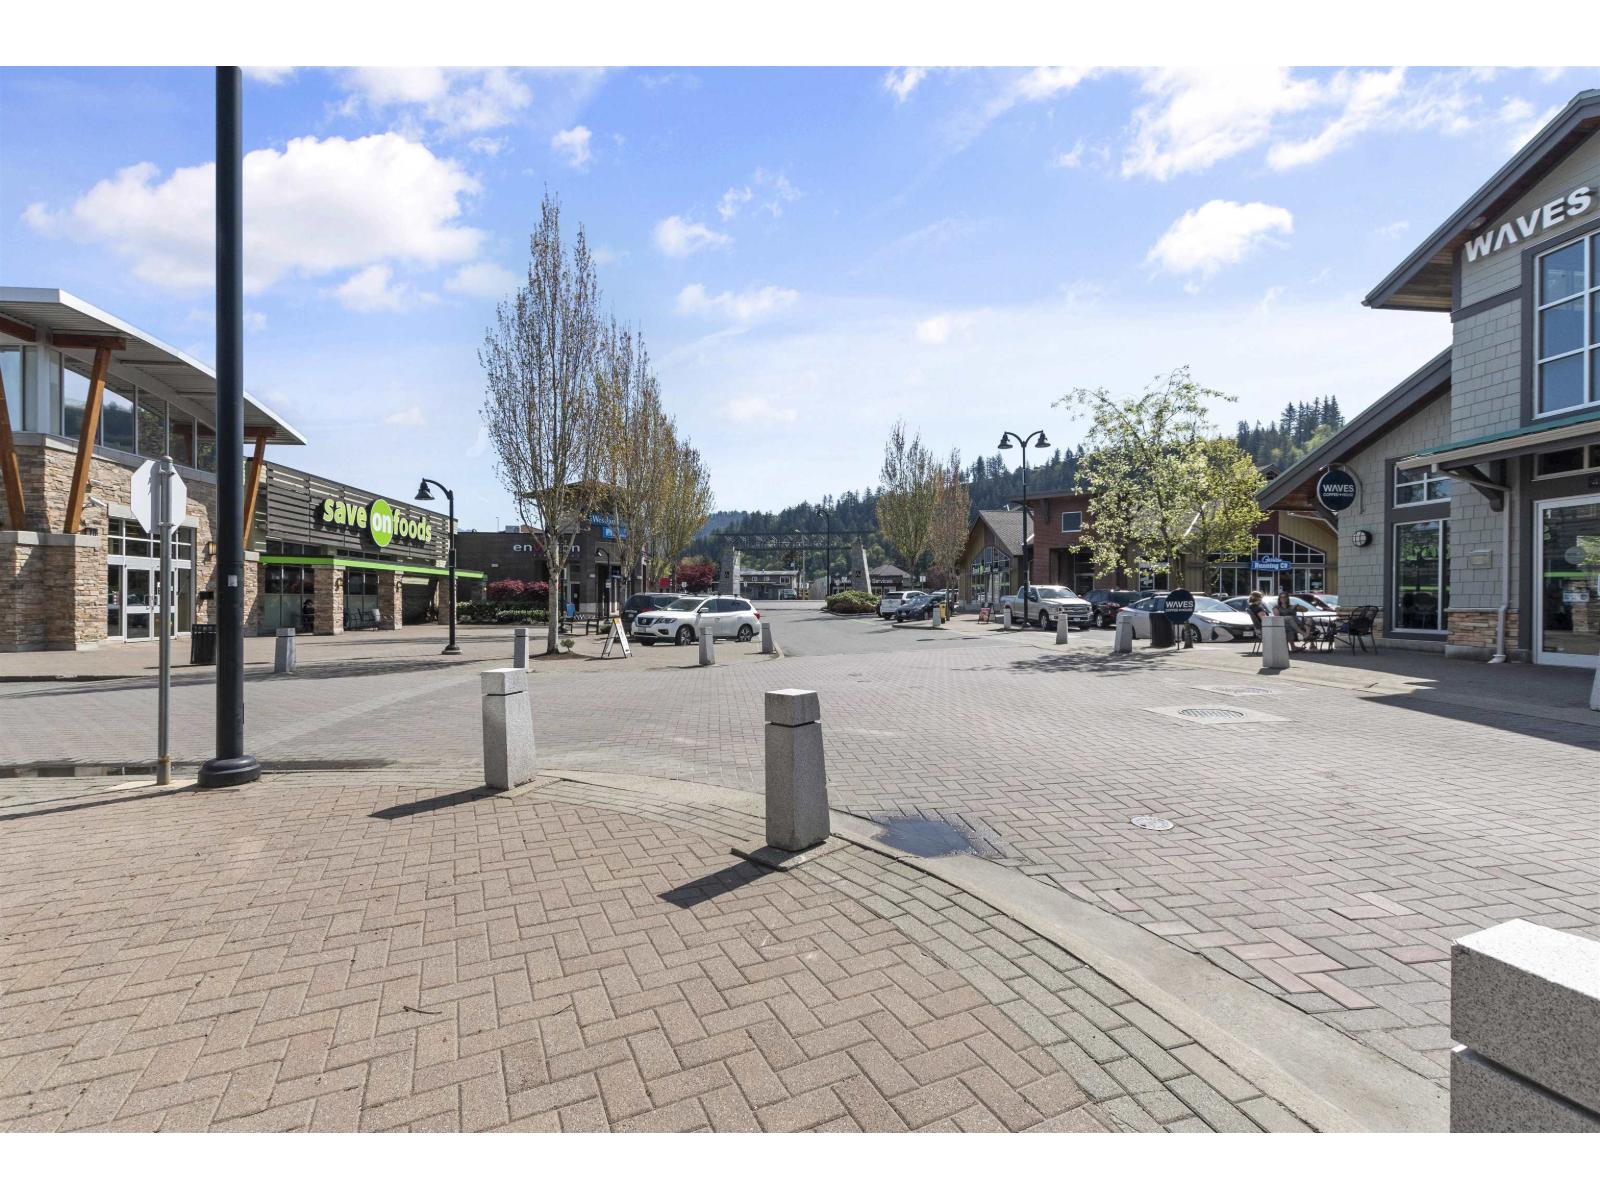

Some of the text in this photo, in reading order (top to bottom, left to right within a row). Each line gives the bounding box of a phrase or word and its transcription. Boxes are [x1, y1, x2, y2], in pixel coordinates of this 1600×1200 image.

[1464, 186, 1592, 262] WAVES
[1322, 484, 1354, 492] WAVES
[323, 499, 432, 543] save on foods
[1165, 600, 1194, 608] WAVES
